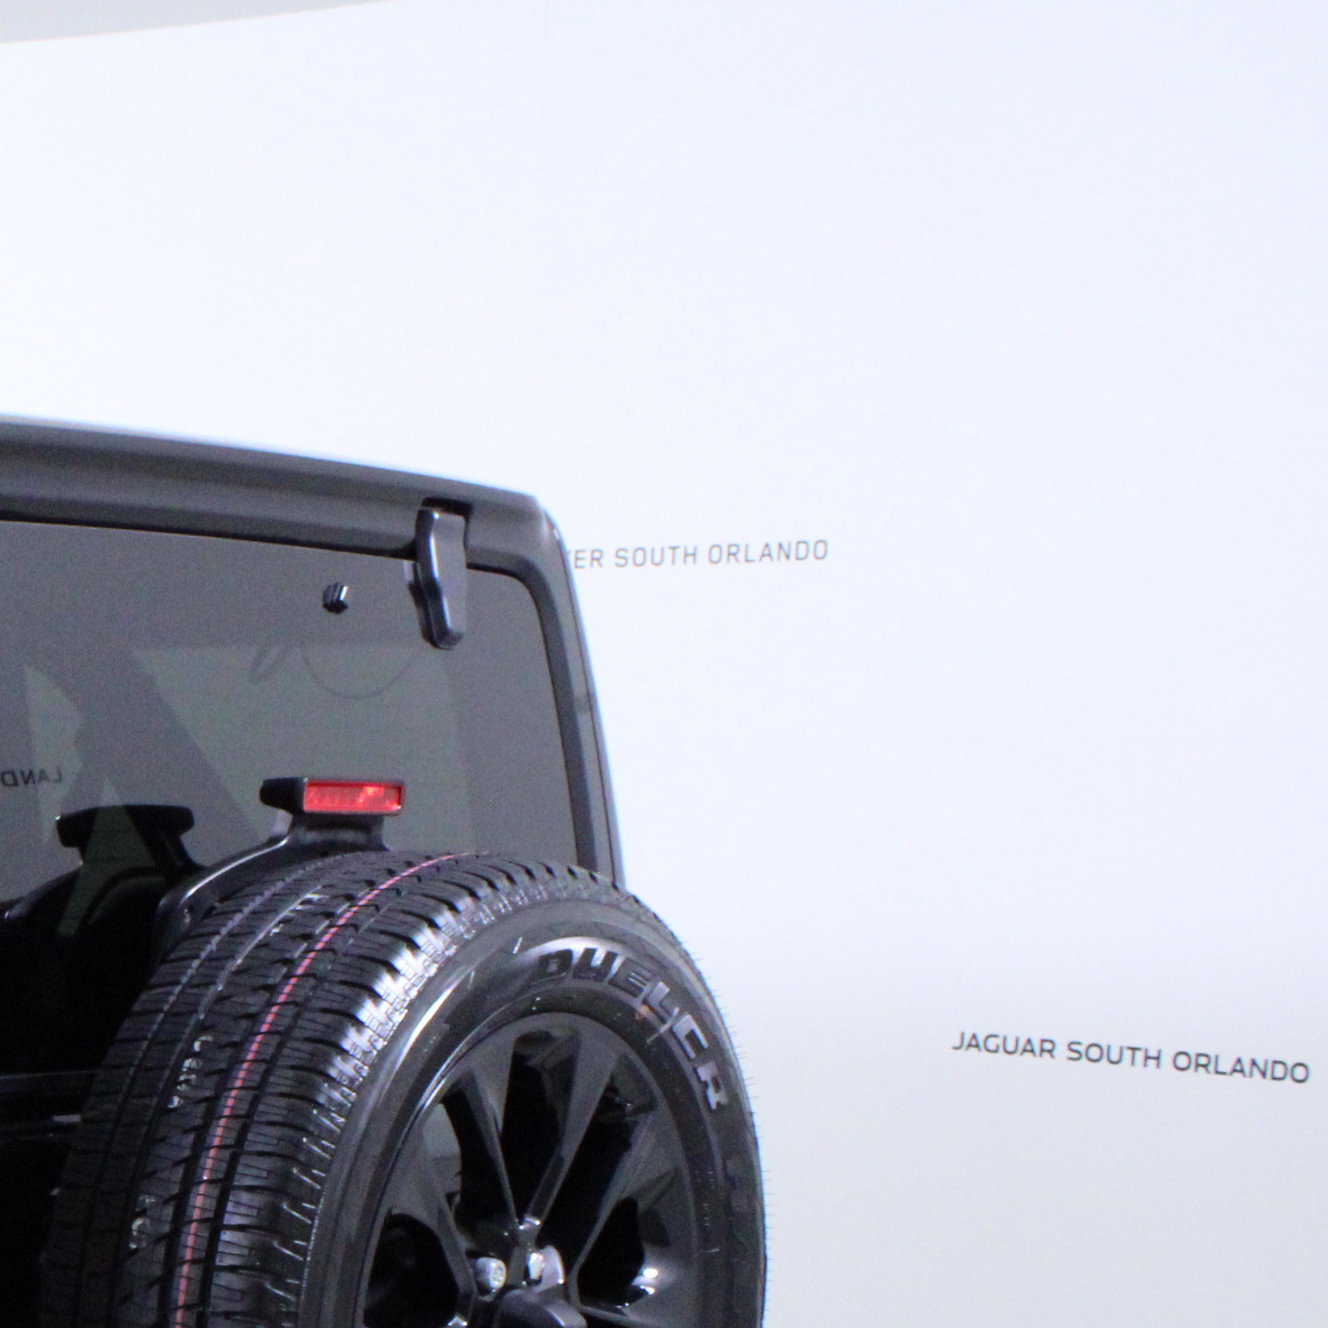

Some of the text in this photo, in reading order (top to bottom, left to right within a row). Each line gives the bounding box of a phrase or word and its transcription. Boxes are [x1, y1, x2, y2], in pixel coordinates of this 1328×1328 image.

[615, 545, 697, 568] SOUTH
[708, 539, 829, 565] ORLANDO
[952, 1031, 1310, 1085] JAGUAR SOUTH ORLANDO
